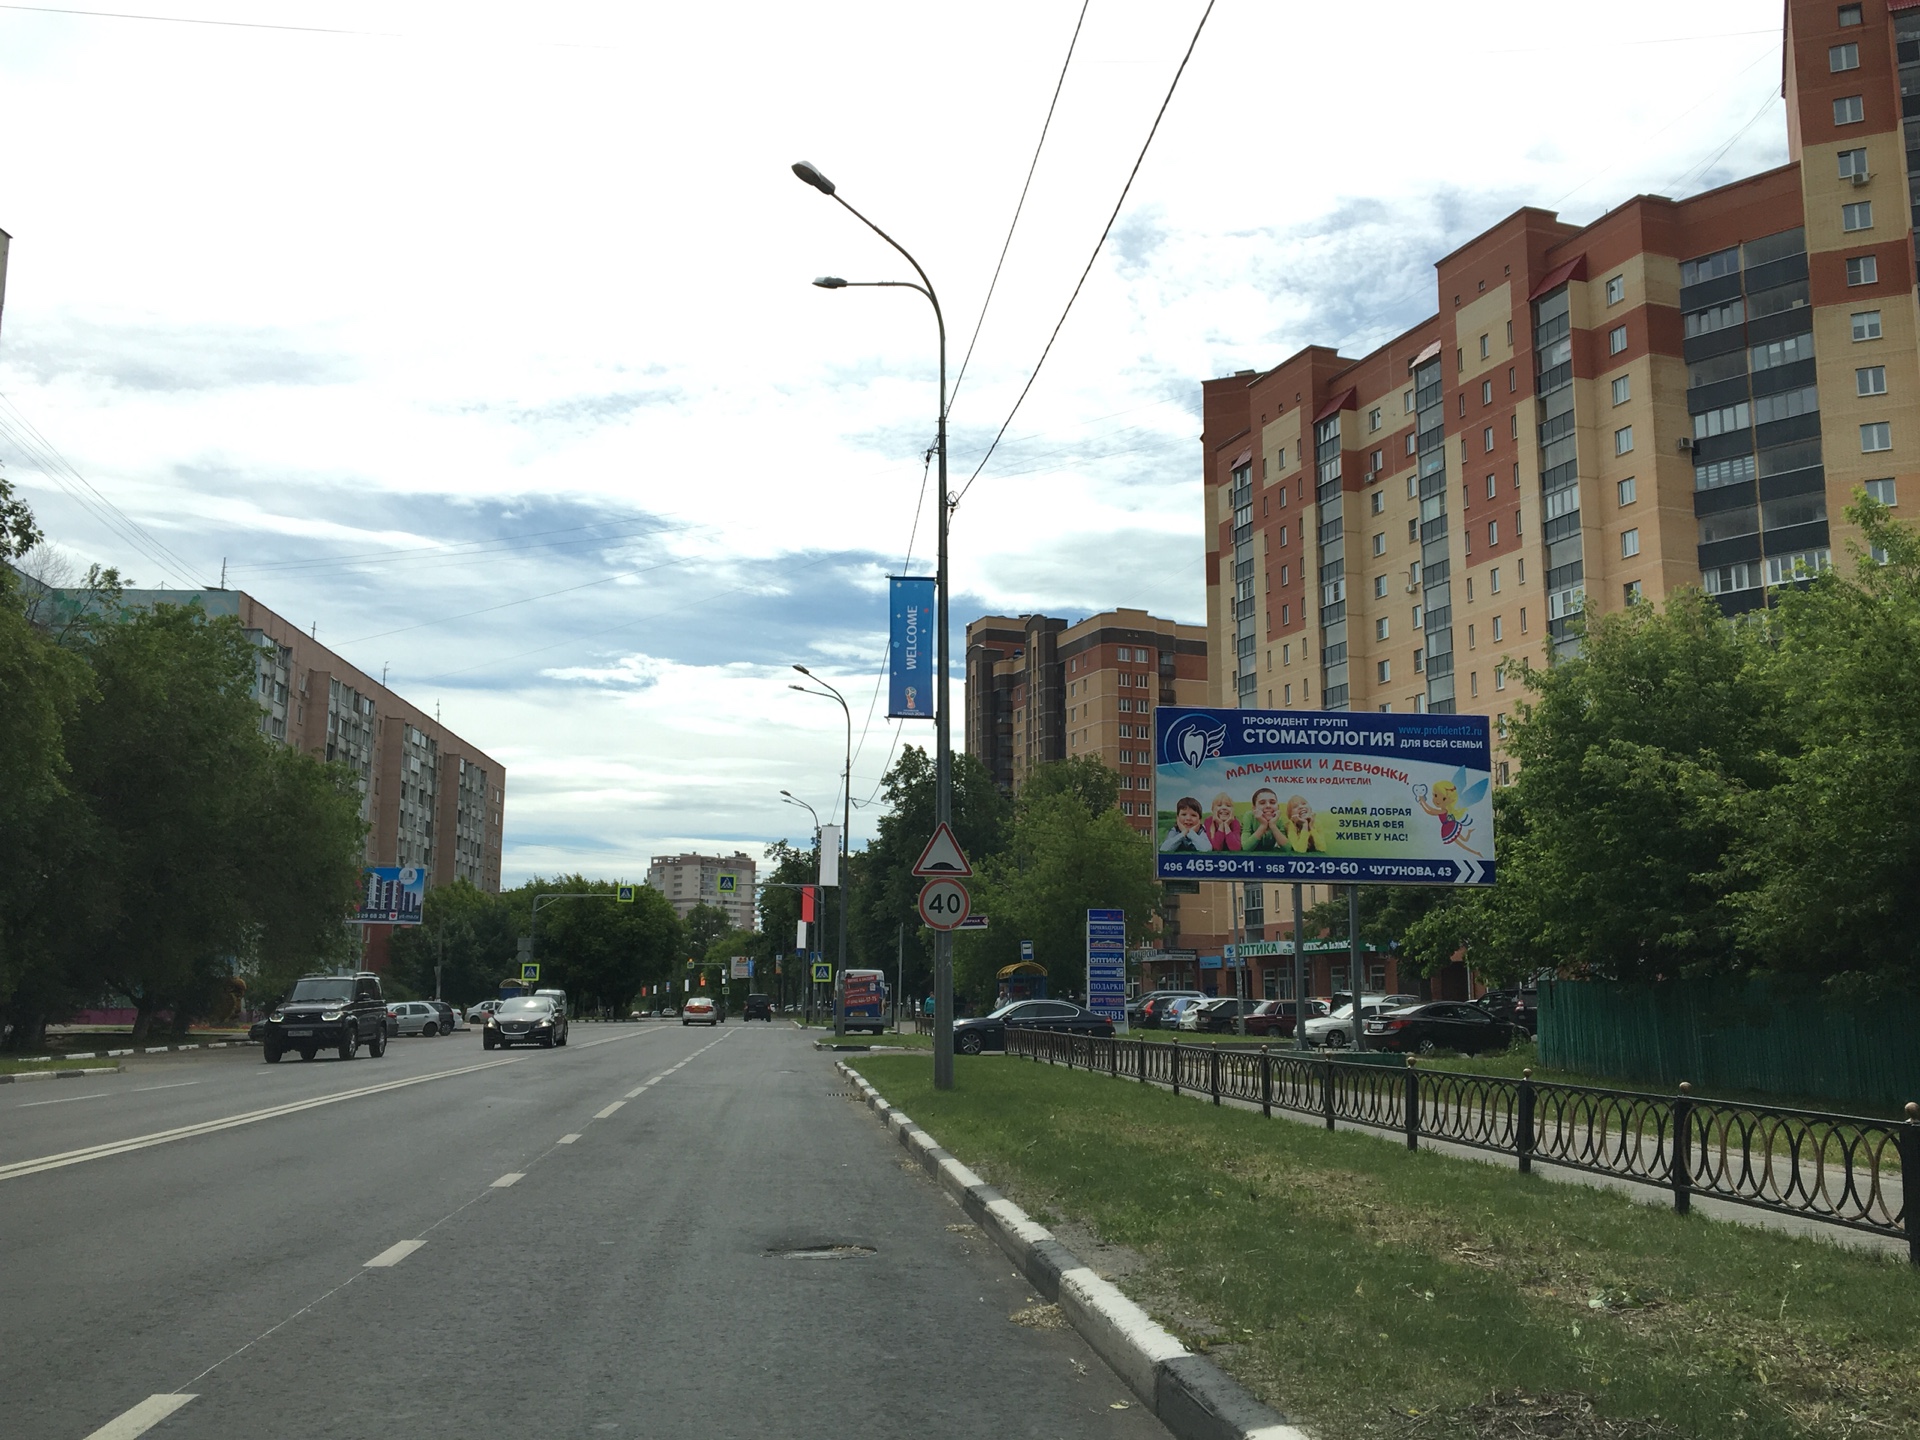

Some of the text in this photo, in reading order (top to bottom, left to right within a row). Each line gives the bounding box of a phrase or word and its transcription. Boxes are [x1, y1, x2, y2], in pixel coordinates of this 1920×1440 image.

[906, 604, 918, 671] WELCOME
[1242, 716, 1348, 727] ПРОФИДЕНТ ГРУПП
[1398, 725, 1482, 737] www.profident12.ru
[1242, 728, 1395, 747] СТОМАТОЛОГИЯ
[1400, 738, 1483, 749] ДЛЯ ВСЕЙ СЕМЬИ
[1226, 758, 1313, 780] МАЛЬЧИШКИ
[1319, 758, 1329, 770] И
[1264, 775, 1371, 785] А ТАКЖЕ ИХ РОДИТЕЛИ!
[1330, 806, 1412, 817] САМАЯ ДОБРАЯ
[1338, 819, 1404, 829] ЗУБНАЯ ФЕЯ
[1336, 832, 1409, 842] ЖИВЕТ У НАС!
[1163, 859, 1452, 878] 496 465-90-11 968 702-19-60 ЧУГУНОВА, 43
[929, 893, 961, 914] 40
[1238, 943, 1278, 956] ОПТИКА
[1090, 956, 1124, 964] ОПТИКА
[1090, 983, 1124, 992] ПОДАРКИ
